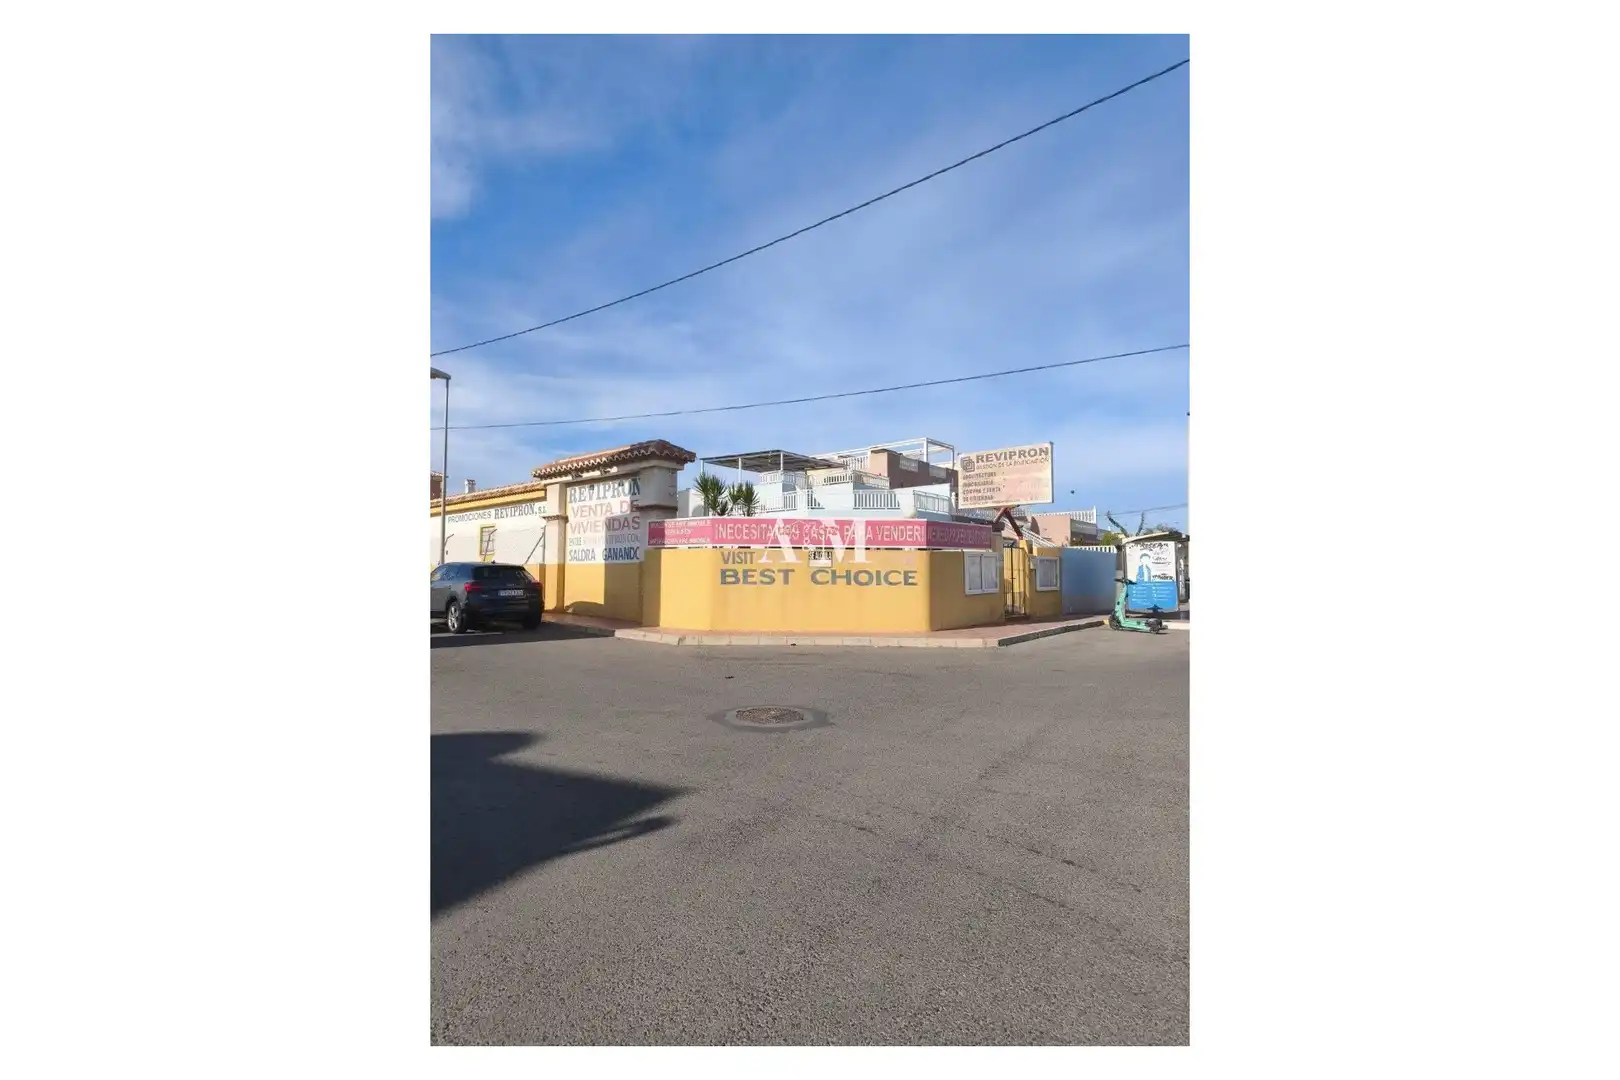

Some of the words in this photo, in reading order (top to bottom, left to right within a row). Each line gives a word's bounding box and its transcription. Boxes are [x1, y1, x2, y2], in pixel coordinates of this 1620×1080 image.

[976, 447, 1049, 463] REVIPRON
[568, 478, 640, 503] REVIPRON
[447, 511, 491, 523] PROMOCIONES
[571, 502, 613, 518] VENTA
[620, 500, 639, 513] DE
[569, 516, 640, 534] VIVIENDAS
[876, 526, 925, 541] VENDER!
[568, 548, 596, 561] SALDRA
[721, 551, 755, 565] VISIT
[720, 569, 795, 585] BEST
[810, 569, 918, 586] CHOICE
